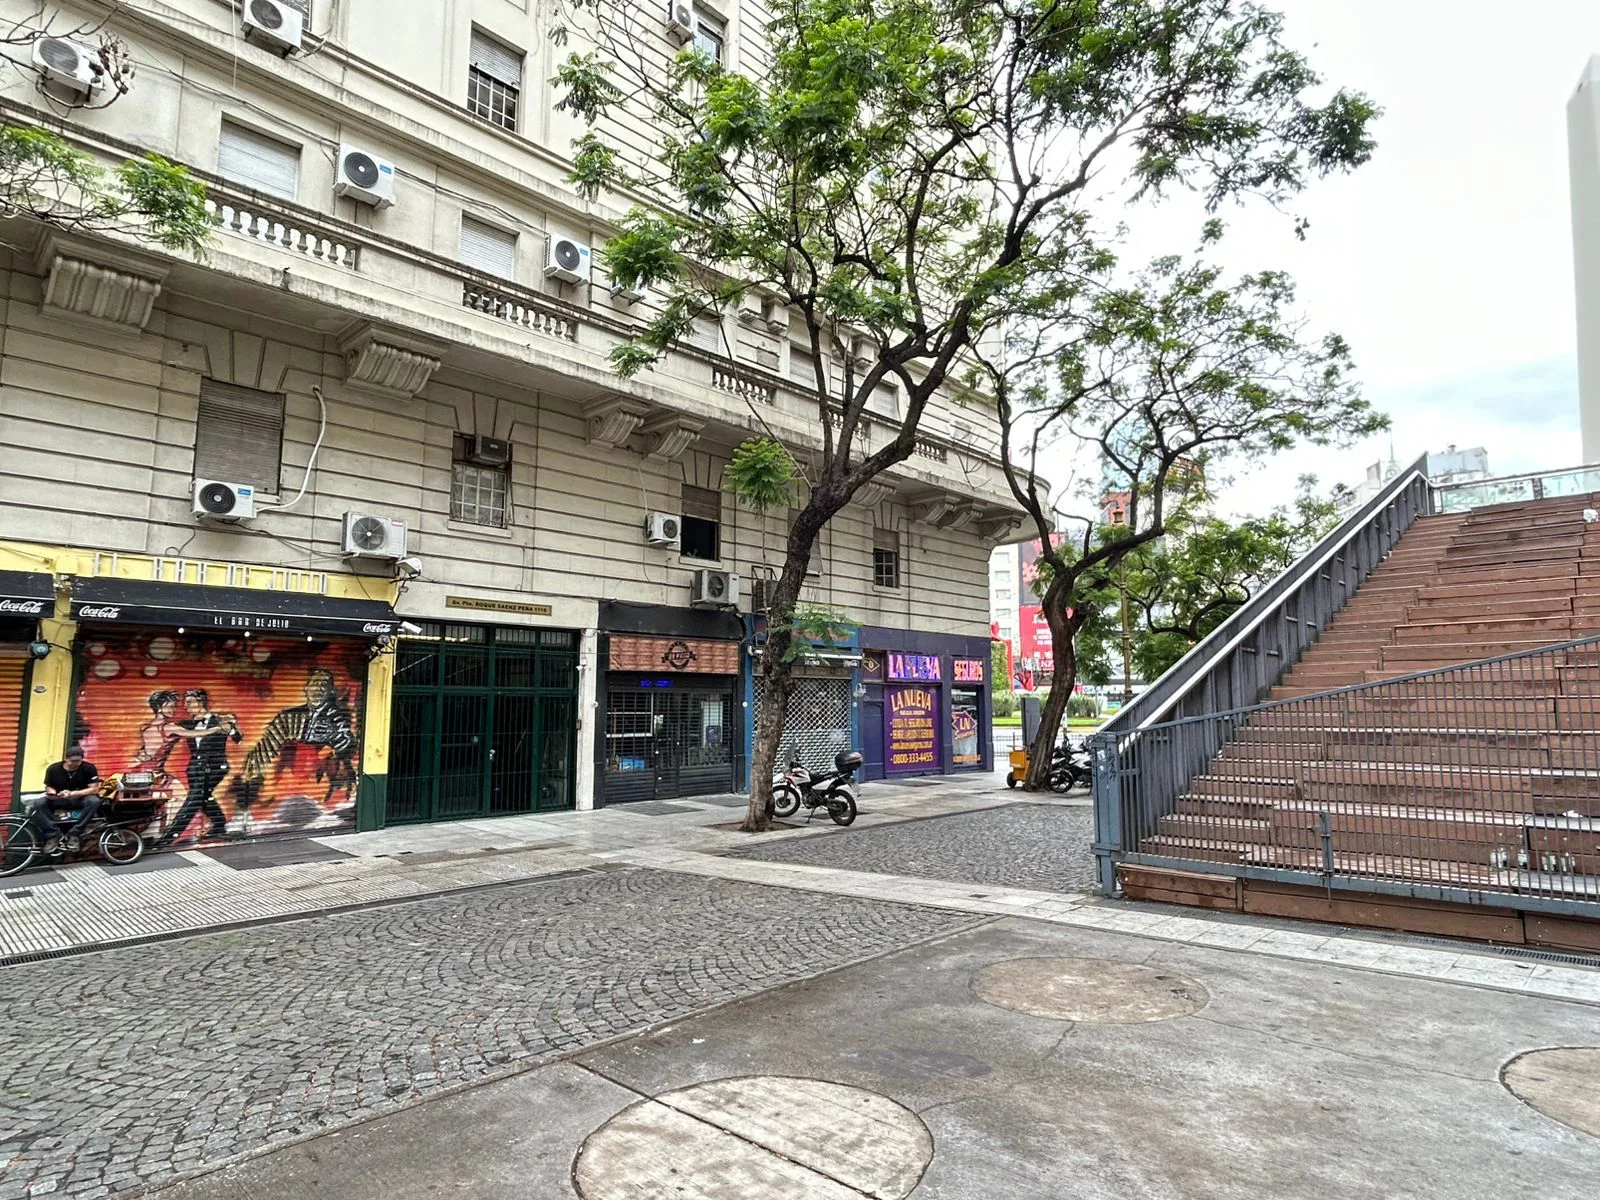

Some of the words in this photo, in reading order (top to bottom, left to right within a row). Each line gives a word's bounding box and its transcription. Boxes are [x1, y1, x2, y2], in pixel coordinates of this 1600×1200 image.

[231, 617, 249, 626] BAR
[256, 618, 264, 627] DE
[268, 619, 289, 628] JULIO
[888, 655, 904, 679] LA
[891, 692, 905, 711] LA
[904, 689, 931, 711] NUEVA
[960, 718, 971, 730] LN
